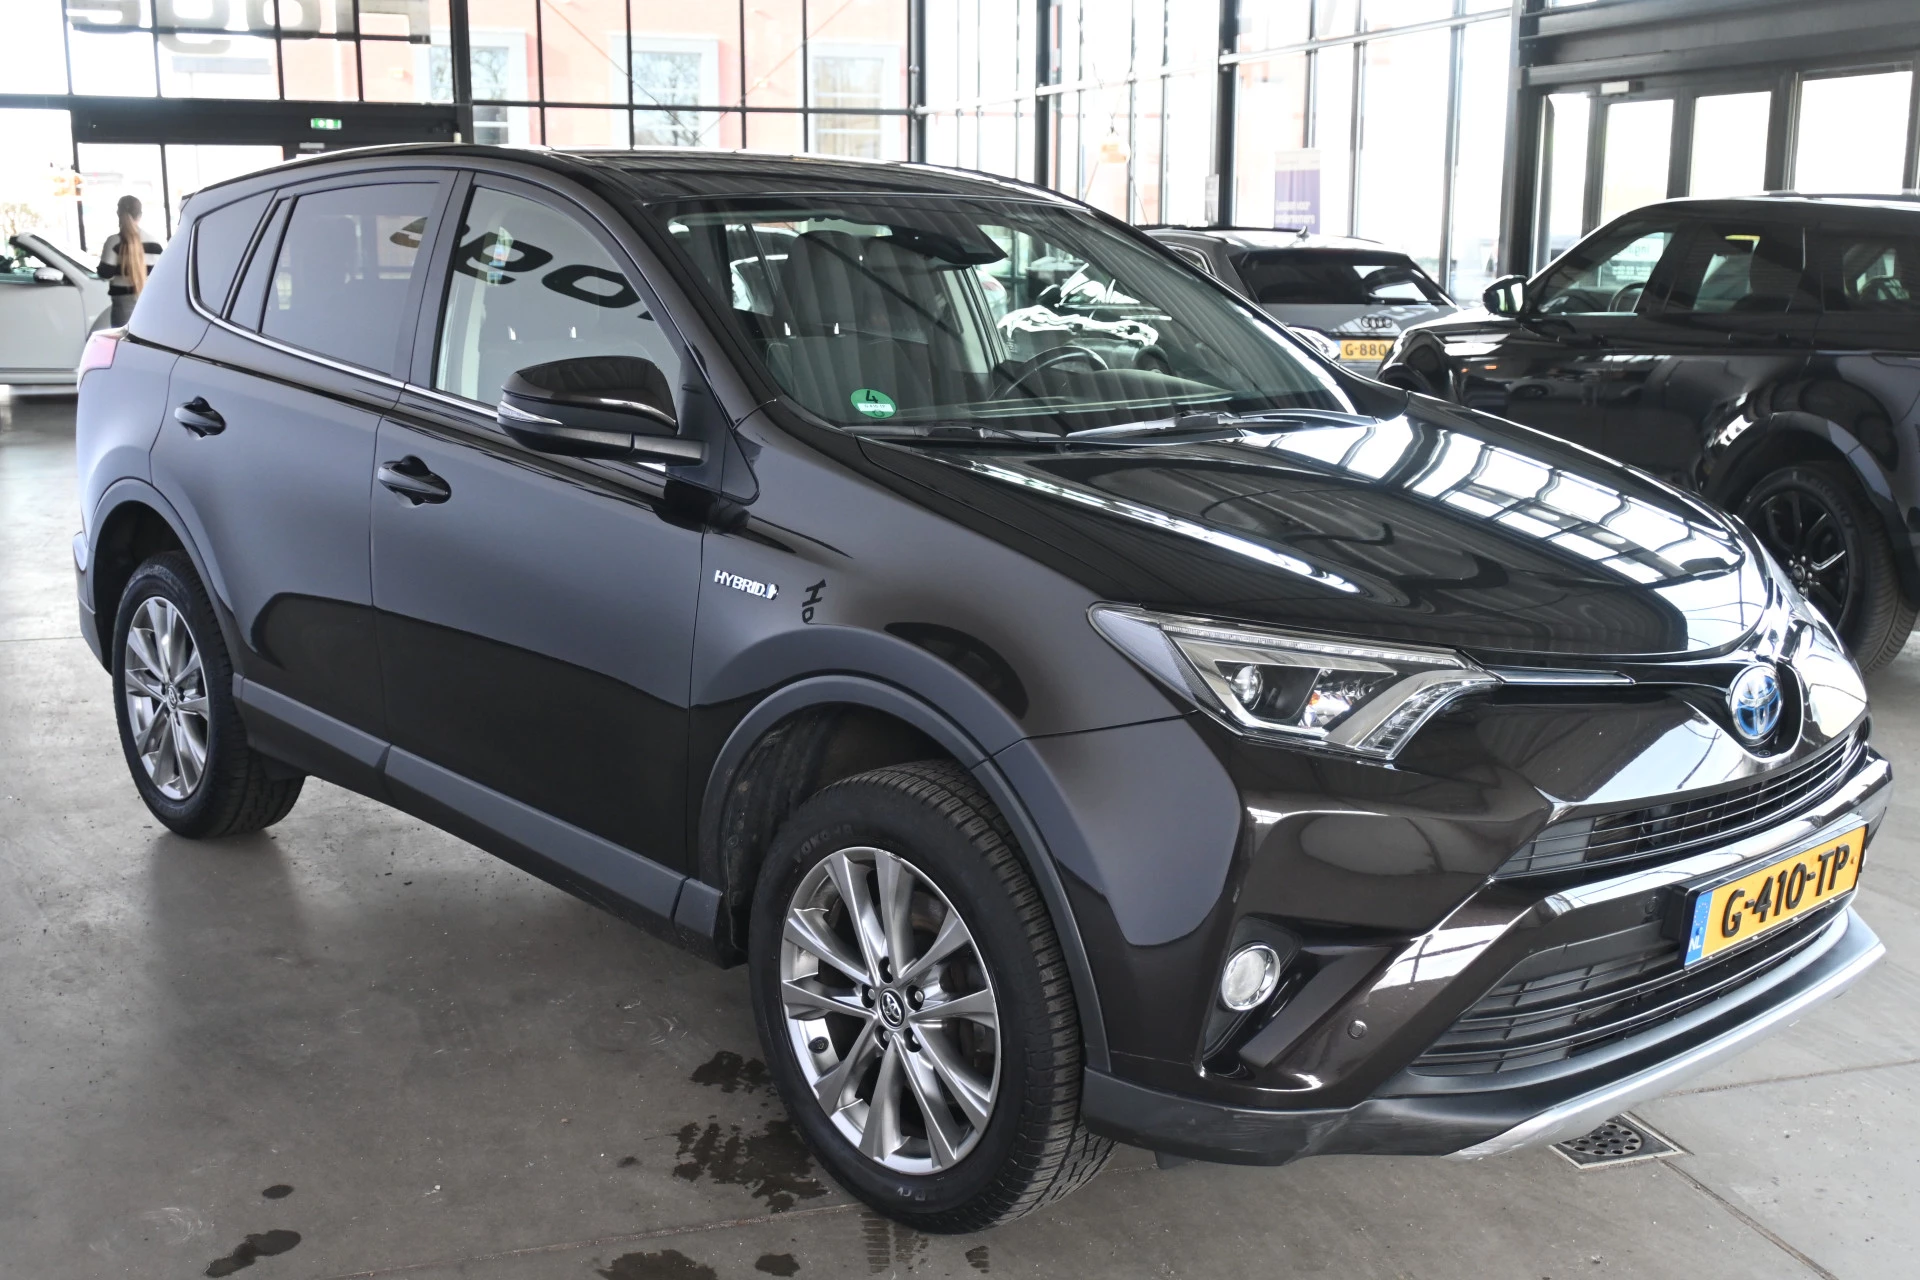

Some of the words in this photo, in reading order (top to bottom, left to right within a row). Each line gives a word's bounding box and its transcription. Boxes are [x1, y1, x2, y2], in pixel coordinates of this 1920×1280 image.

[866, 390, 879, 403] 4
[714, 570, 766, 597] HYBRID
[1721, 843, 1851, 938] G-410-TP
[1688, 934, 1702, 953] NL
